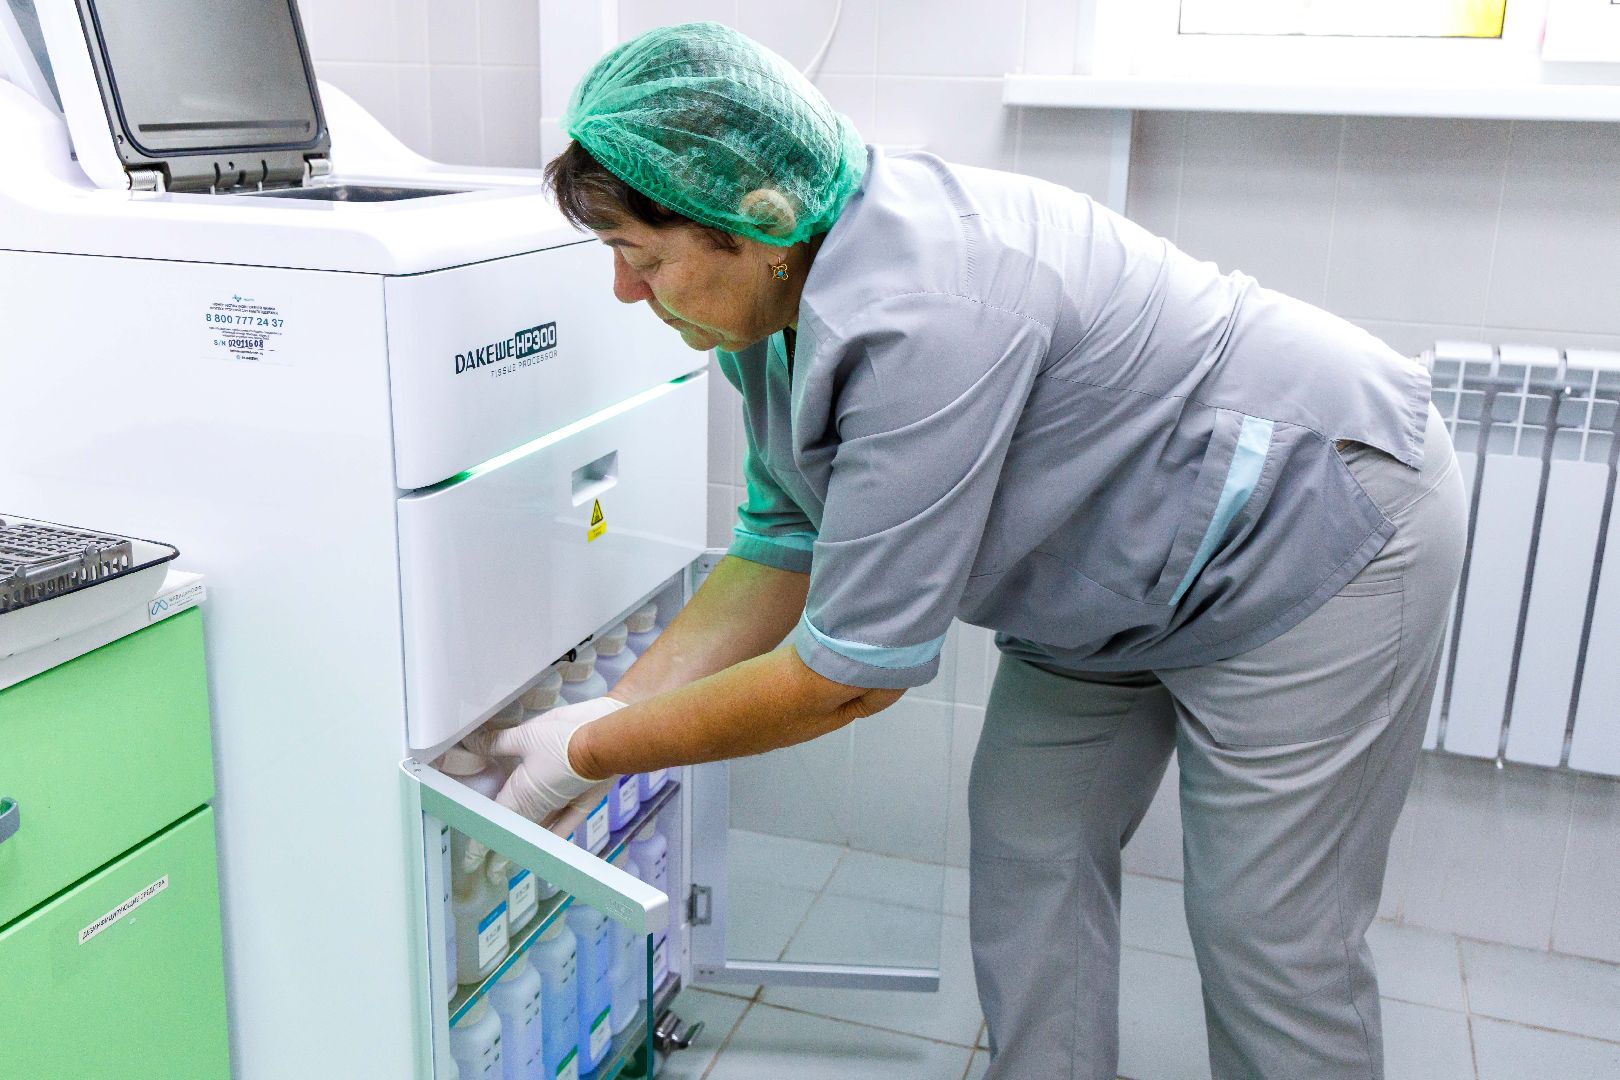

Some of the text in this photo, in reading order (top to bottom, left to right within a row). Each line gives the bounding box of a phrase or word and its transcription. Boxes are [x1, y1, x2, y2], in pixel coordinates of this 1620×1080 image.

[206, 314, 284, 328] 8 800 777 24 37
[455, 324, 556, 375] DAKEWE HP300
[491, 349, 558, 378] TISSUE PROCESSOR
